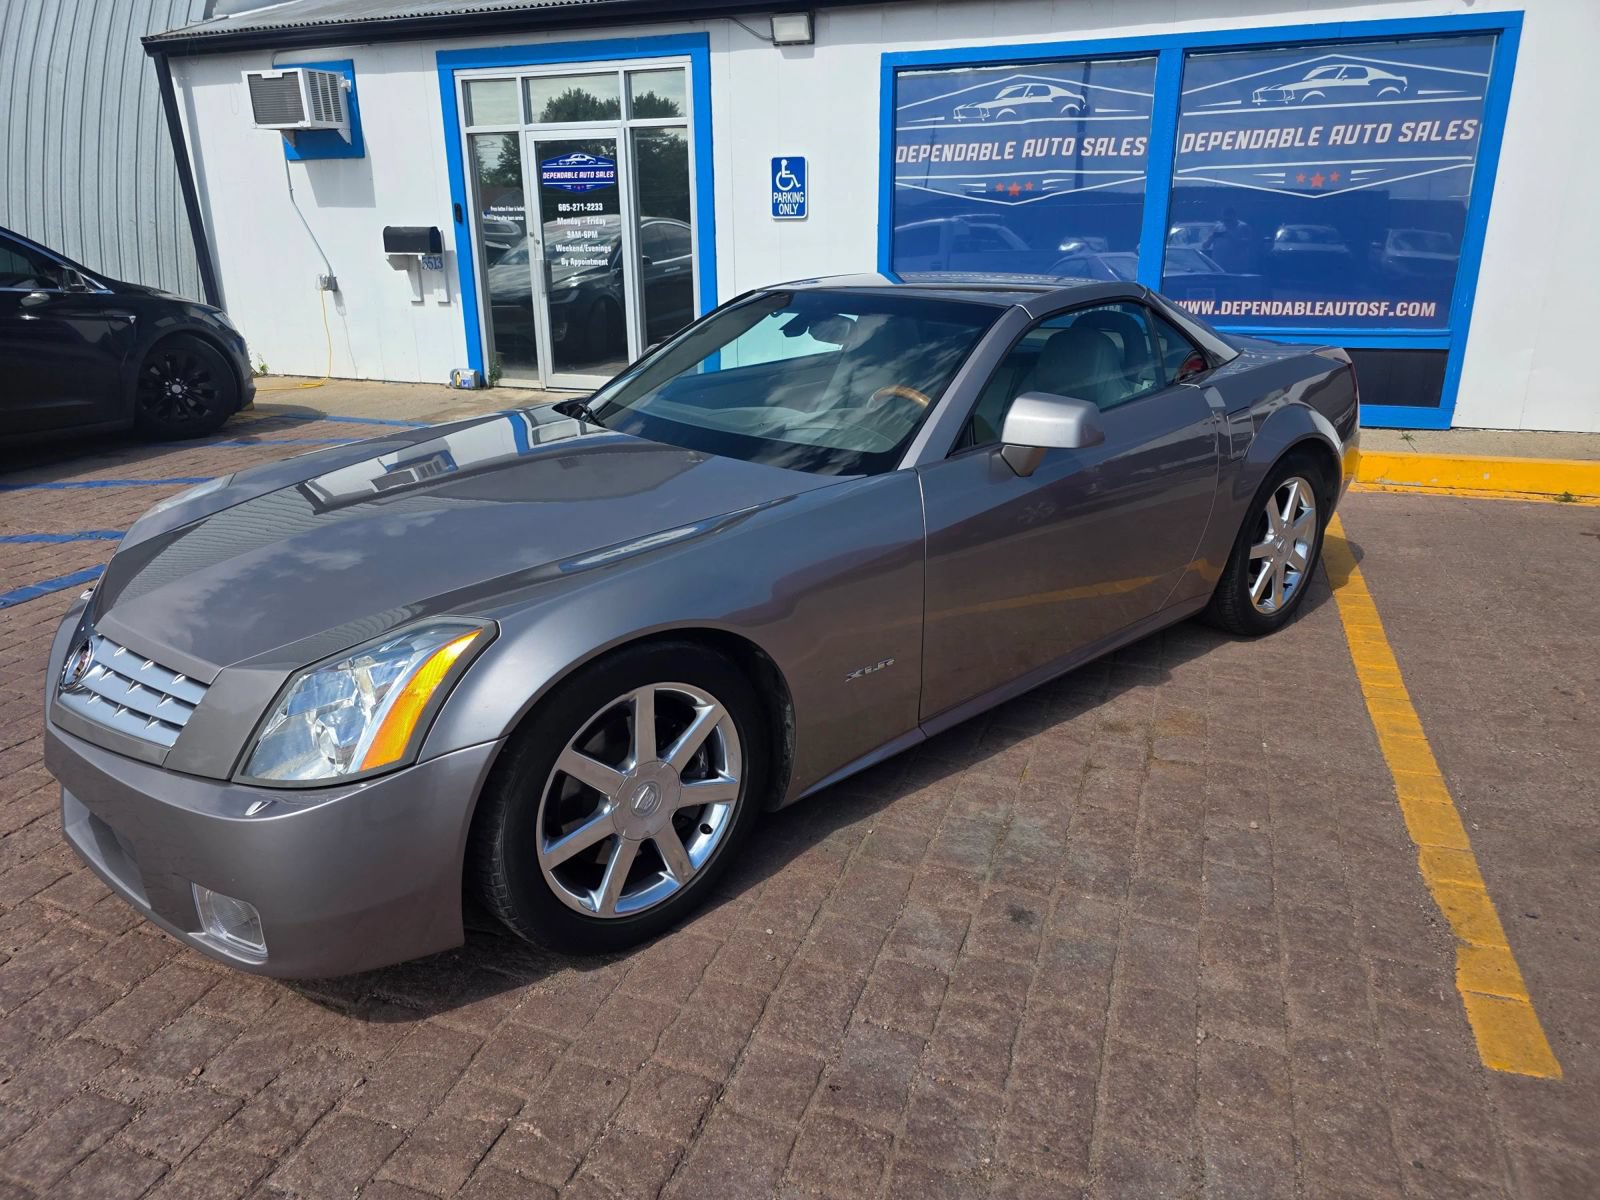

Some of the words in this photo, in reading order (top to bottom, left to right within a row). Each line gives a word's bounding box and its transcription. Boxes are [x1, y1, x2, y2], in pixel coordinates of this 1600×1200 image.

[1180, 126, 1323, 154] DEPENDABLE
[1328, 123, 1392, 145] AUTO
[1398, 119, 1478, 142] SALES
[895, 141, 1017, 163] DEPENDABLE
[1021, 138, 1075, 158] AUTO
[1081, 136, 1148, 156] SALES
[542, 171, 578, 179] DEPENDABLE
[579, 171, 595, 179] AUTO
[595, 170, 614, 178] SALES
[773, 192, 804, 203] PARKING
[558, 203, 603, 212] 605-271-2233
[778, 203, 799, 215] ONLY
[556, 217, 581, 227] Monday
[587, 216, 606, 227] Friday
[566, 230, 598, 239] 9AM-6PM
[555, 244, 612, 253] Weekend/Evenings
[421, 255, 443, 270] 5513
[560, 257, 569, 267] By
[570, 257, 608, 267] Appointment
